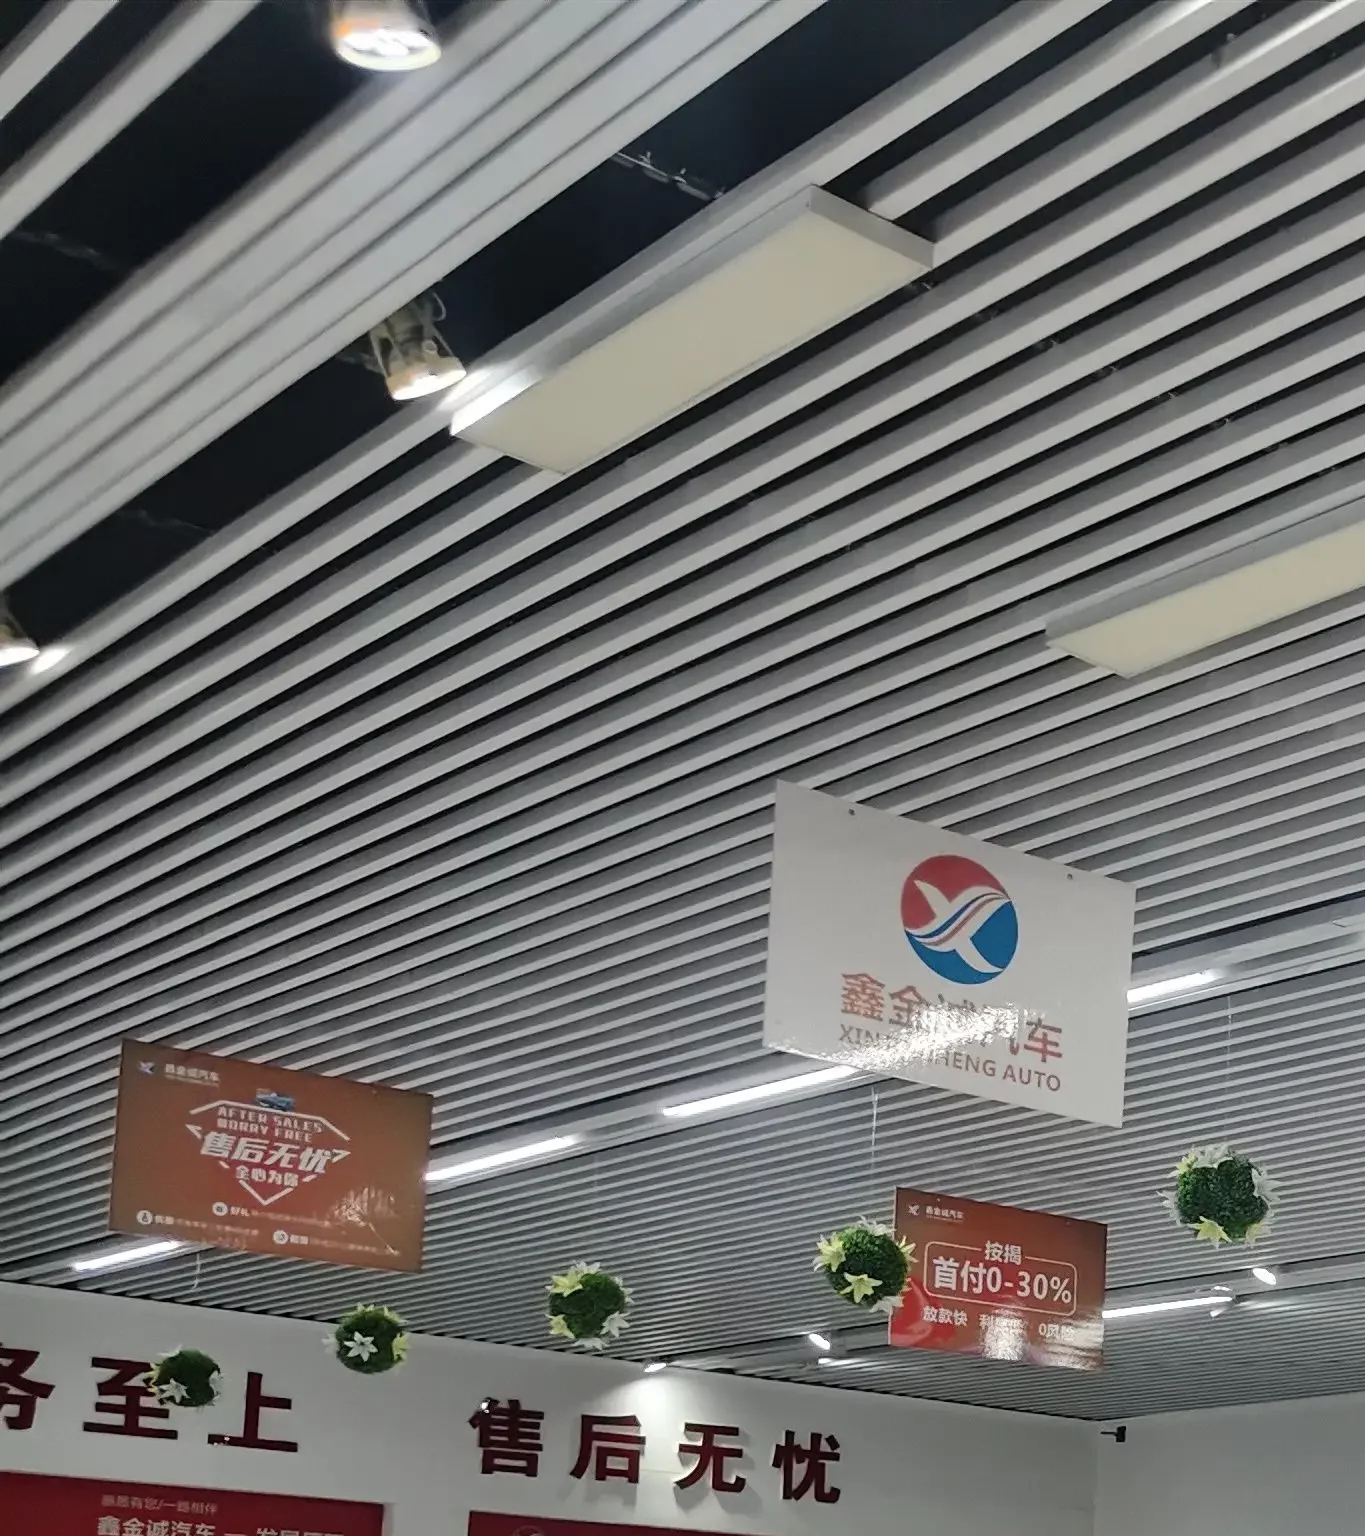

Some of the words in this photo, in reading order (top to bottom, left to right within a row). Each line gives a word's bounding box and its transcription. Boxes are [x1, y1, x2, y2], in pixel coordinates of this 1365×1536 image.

[841, 972, 1063, 1063] 鑫金车
[1002, 1064, 1061, 1092] AUTO
[217, 1120, 269, 1134] WORRY
[275, 1128, 312, 1143] FREE
[218, 1106, 267, 1124] AFTER
[272, 1116, 323, 1133] SALES
[201, 1131, 332, 1173] 售后无忧
[984, 1240, 1022, 1265] 按揭
[933, 1255, 1072, 1304] 首付0-30%
[923, 1306, 968, 1327] 放款快
[468, 1397, 841, 1504] 售后无忧
